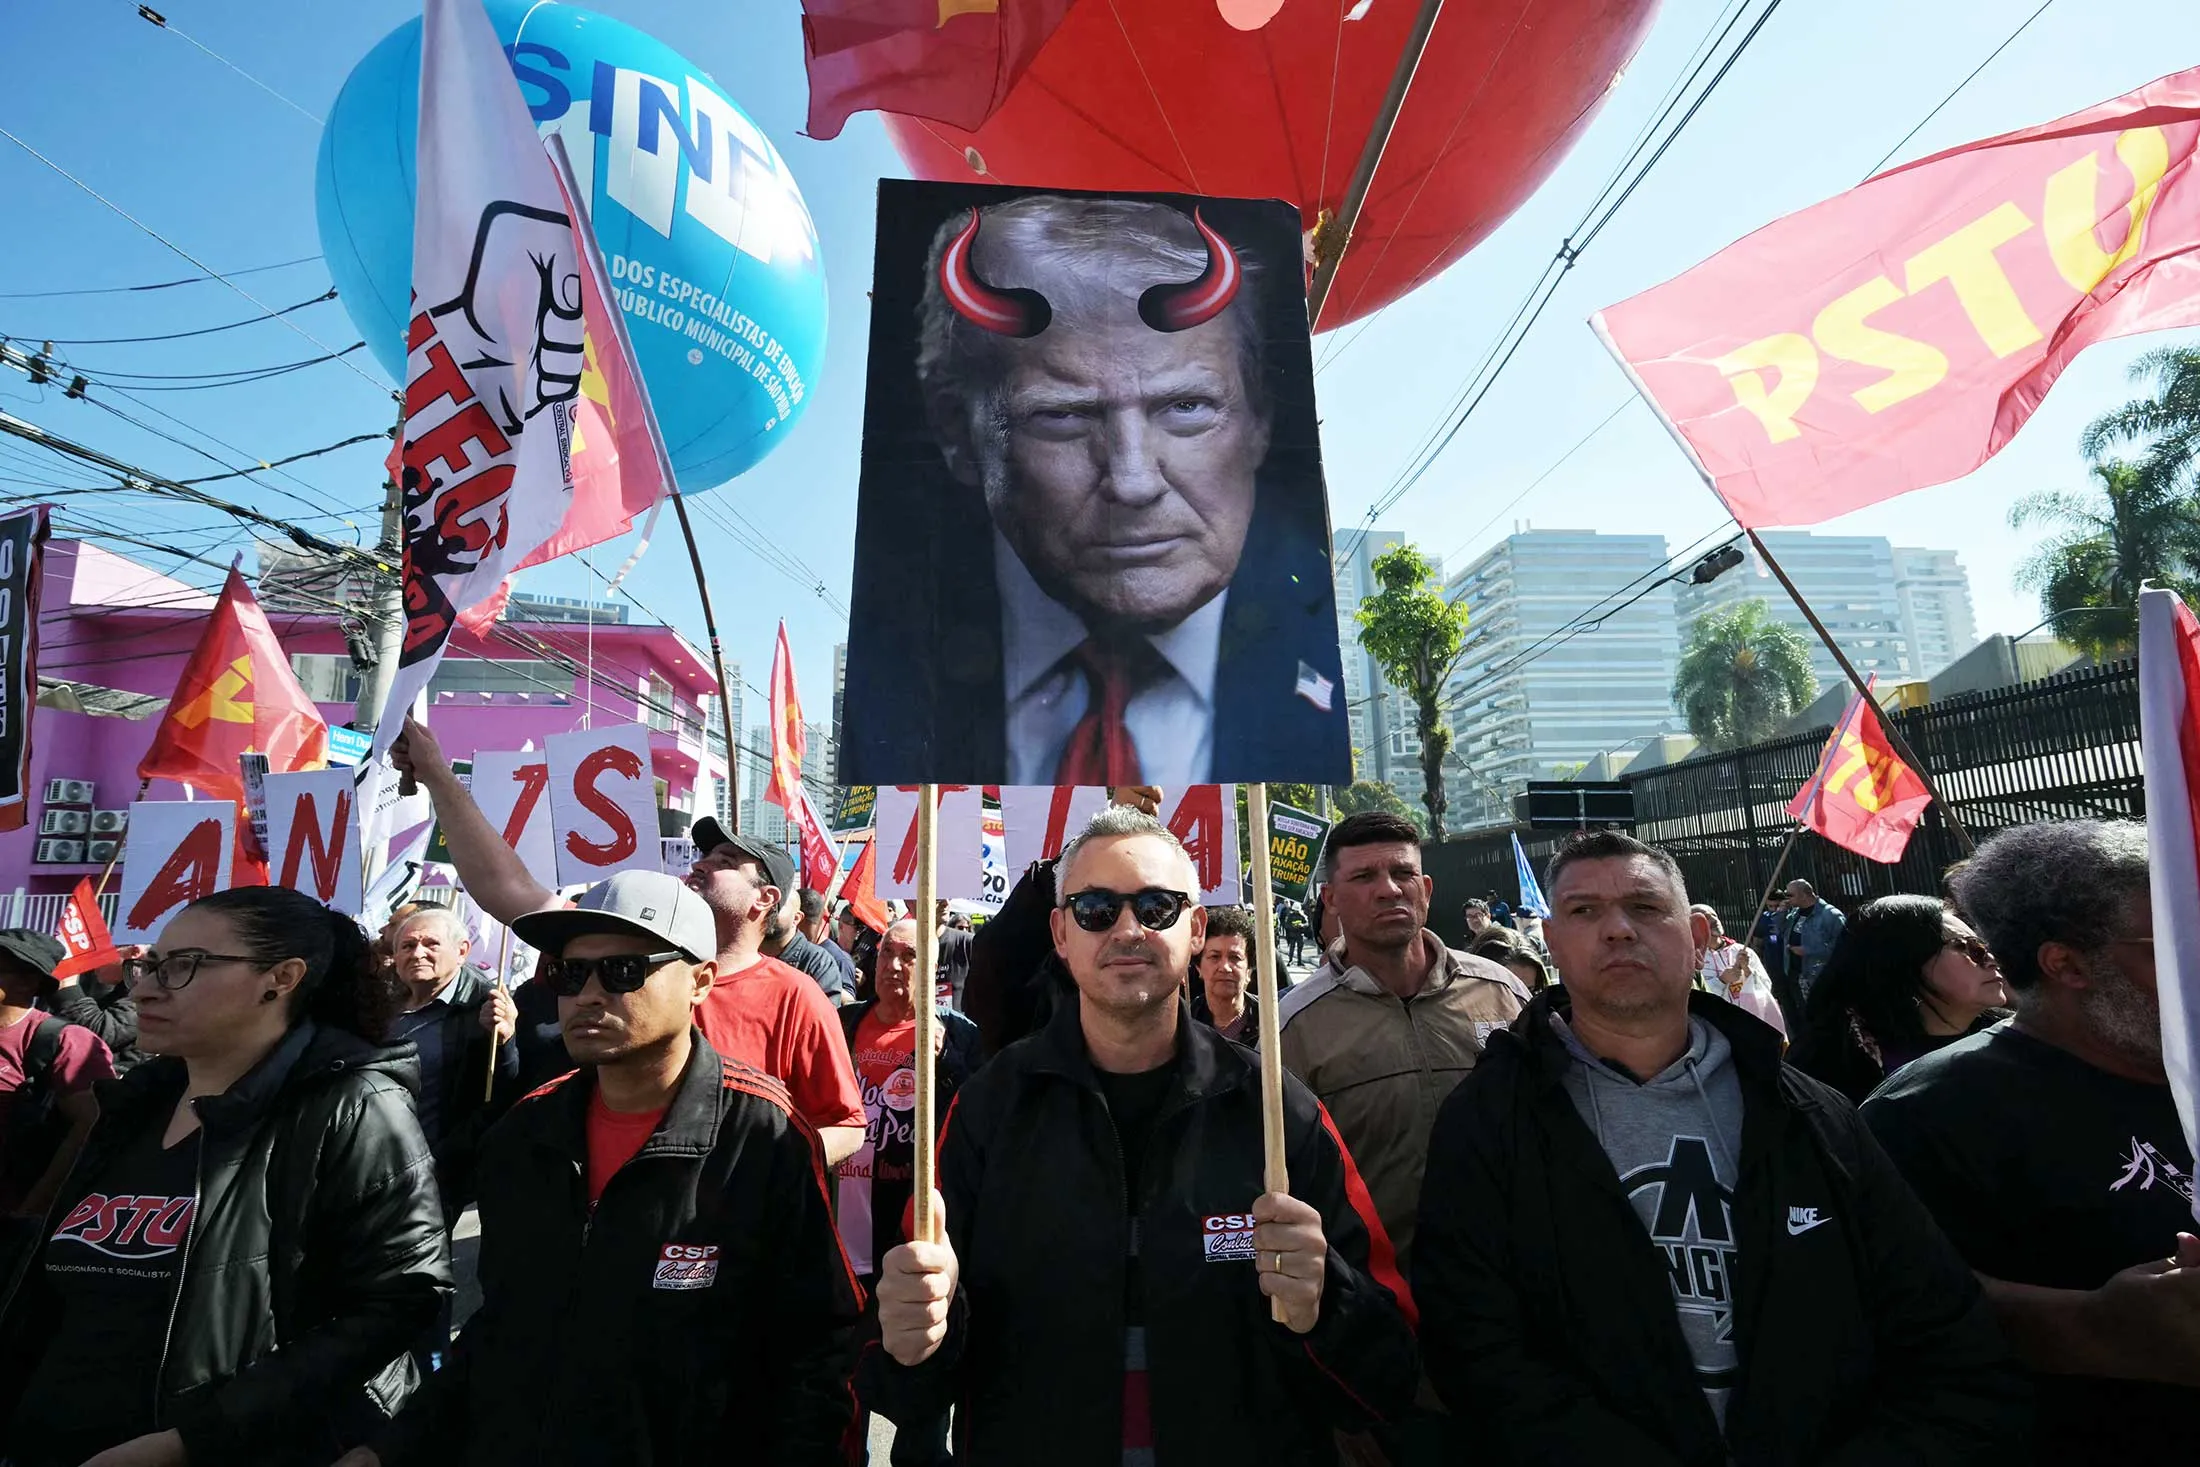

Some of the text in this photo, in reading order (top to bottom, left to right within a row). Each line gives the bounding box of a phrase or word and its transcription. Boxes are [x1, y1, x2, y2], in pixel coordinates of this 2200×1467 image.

[1718, 125, 2169, 444] PSTU
[612, 254, 655, 289] DOS
[658, 271, 768, 349] ESPECIALISTAS
[763, 338, 784, 364] DE
[684, 317, 755, 373] MUNICIPAL
[752, 361, 770, 384] DE
[764, 376, 783, 402] SÃO
[556, 404, 565, 437] CENTRAL
[333, 730, 354, 745] Henri
[566, 745, 644, 867] S
[280, 789, 352, 903] N
[1270, 855, 1310, 874] TAXAÇÃO
[1271, 836, 1308, 860] NÃO
[127, 817, 222, 931] A
[53, 1192, 196, 1247] PSTU
[1789, 1206, 1818, 1225] NIKE
[116, 1267, 172, 1279] SOCIALISTA
[664, 1245, 719, 1259] CSP
